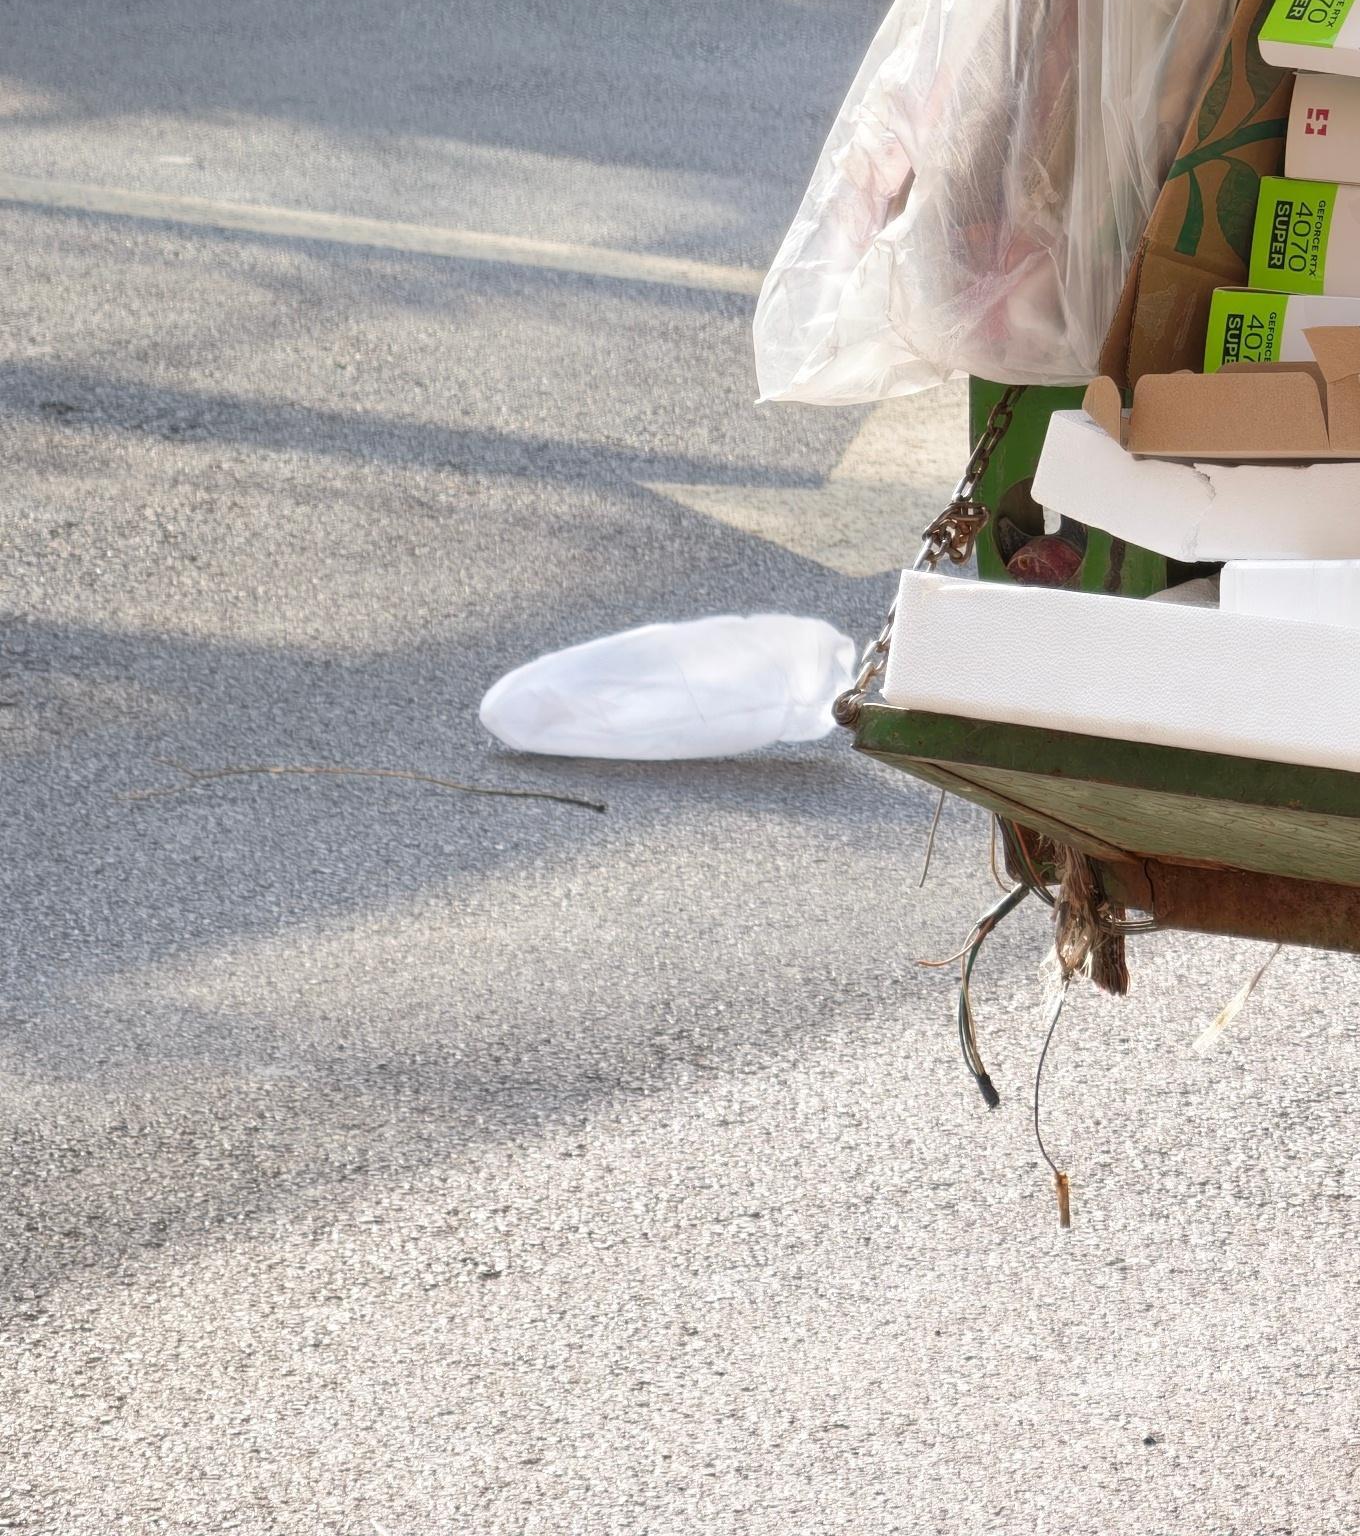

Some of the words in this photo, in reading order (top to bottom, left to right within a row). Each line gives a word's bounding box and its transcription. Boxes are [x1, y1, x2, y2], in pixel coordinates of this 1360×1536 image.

[1326, 9, 1341, 28] RTX
[1269, 203, 1290, 267] SUPER
[1288, 202, 1314, 272] 4070
[1311, 200, 1326, 252] GEFORCE
[1309, 253, 1318, 276] RTX
